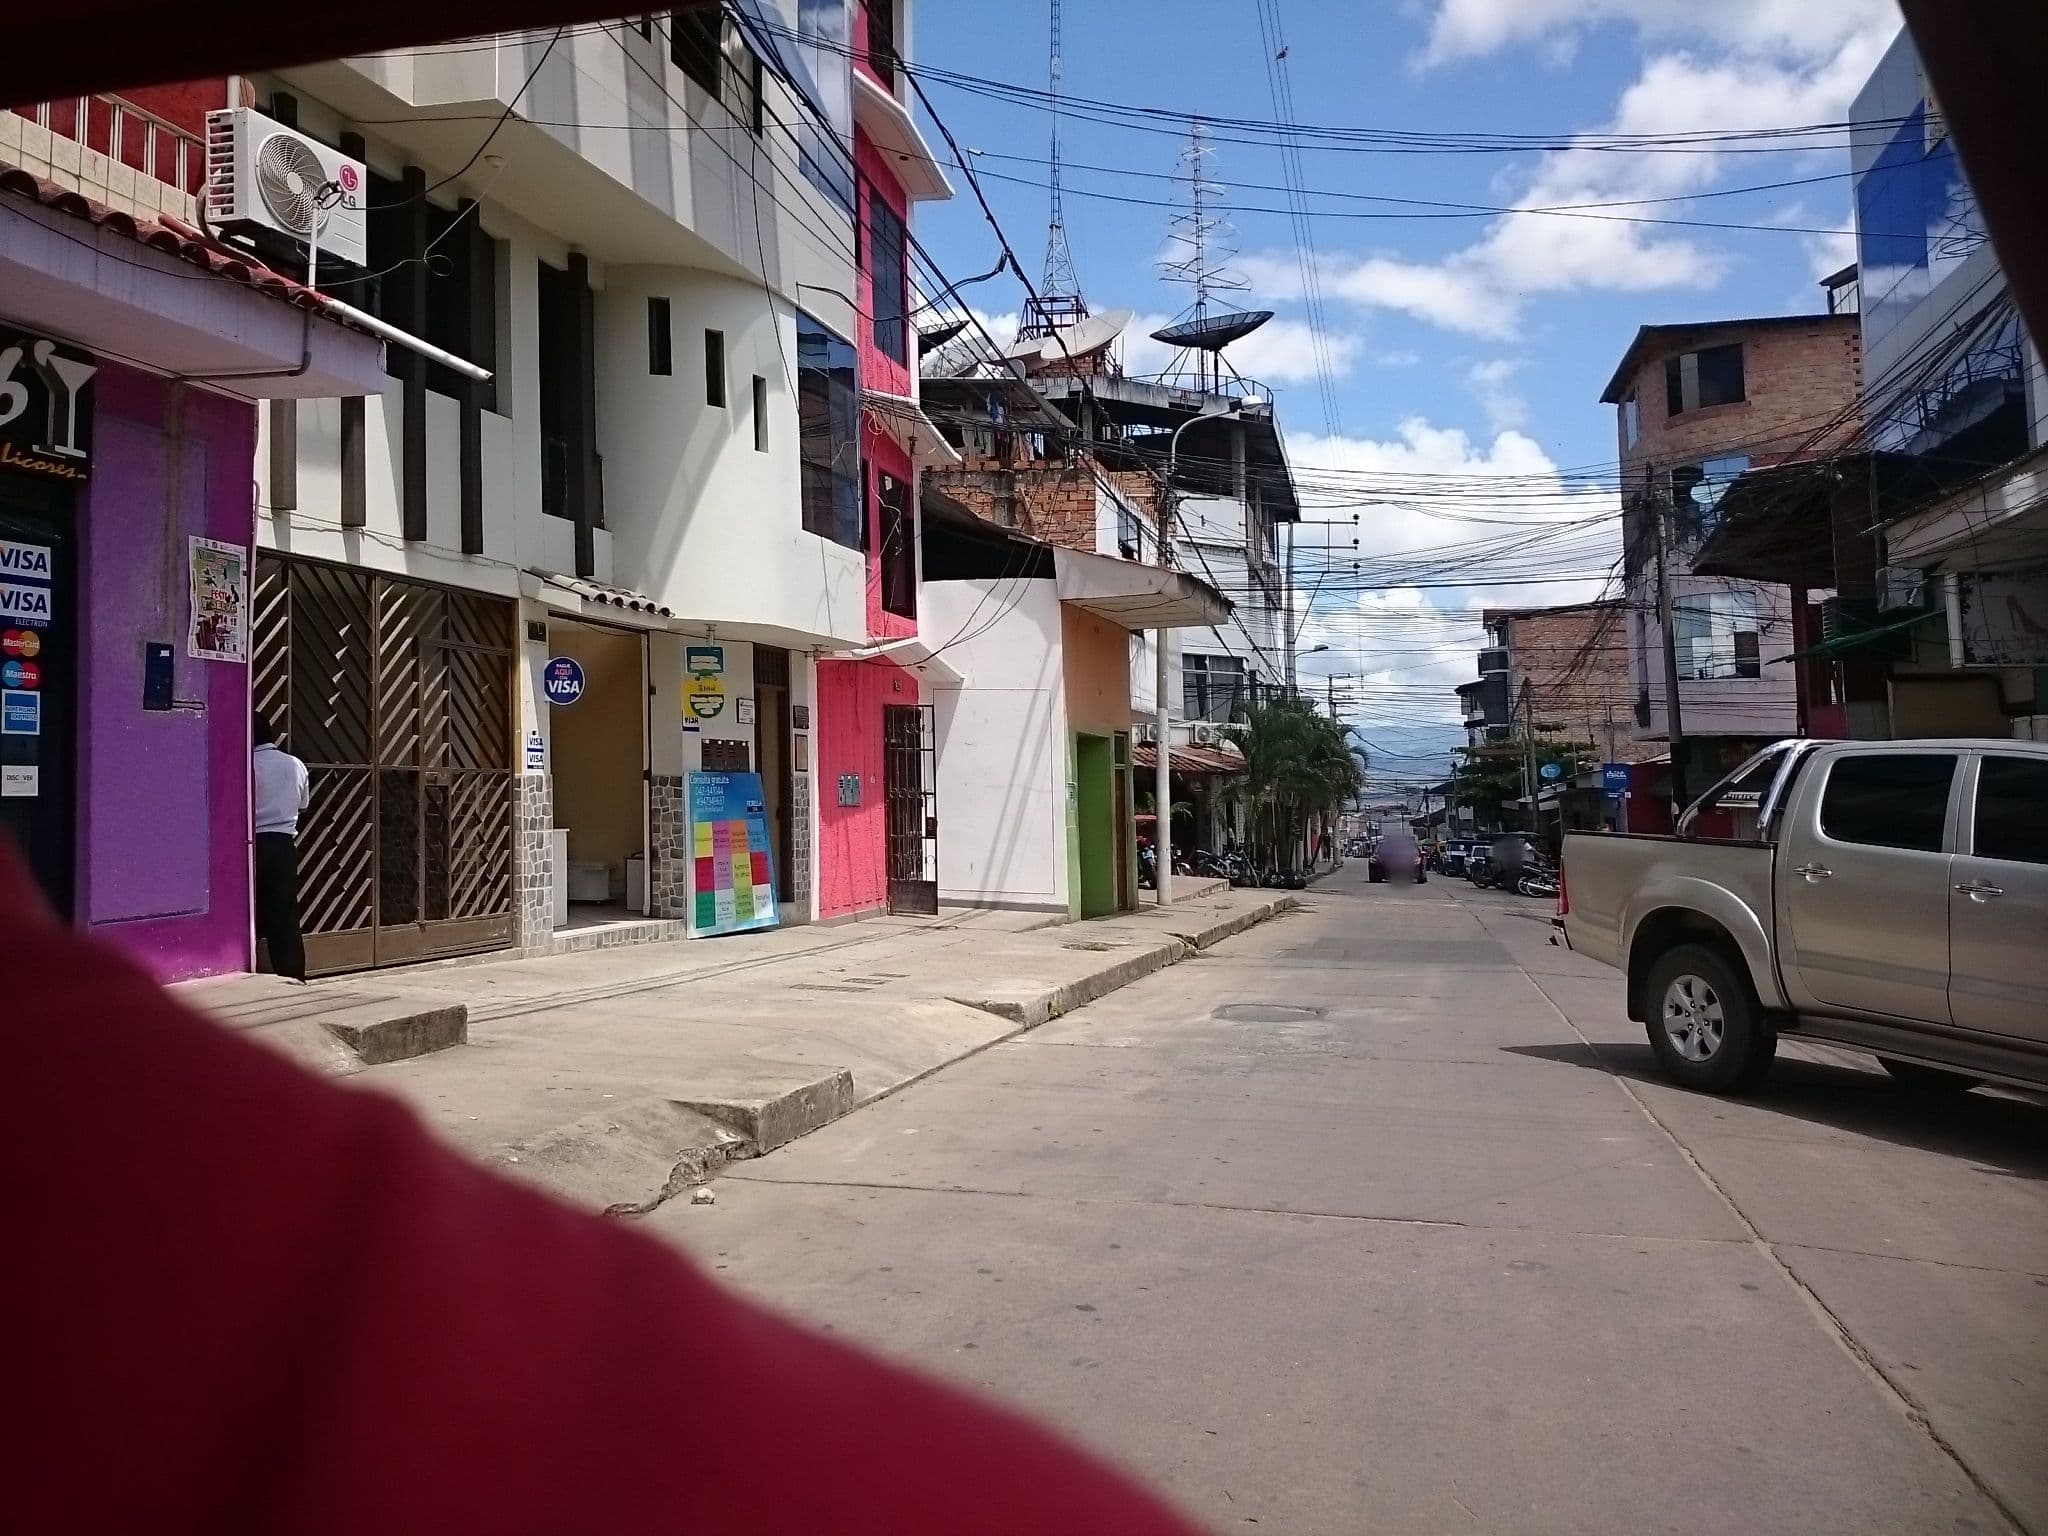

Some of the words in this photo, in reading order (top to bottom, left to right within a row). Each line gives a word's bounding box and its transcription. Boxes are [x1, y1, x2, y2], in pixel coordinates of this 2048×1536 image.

[0, 548, 48, 572] VISA
[0, 590, 48, 613] VISA
[15, 618, 48, 627] ELECTRON
[5, 670, 37, 680] Maestro
[547, 680, 580, 694] VISA
[529, 737, 544, 746] VISA
[529, 754, 544, 764] VISA
